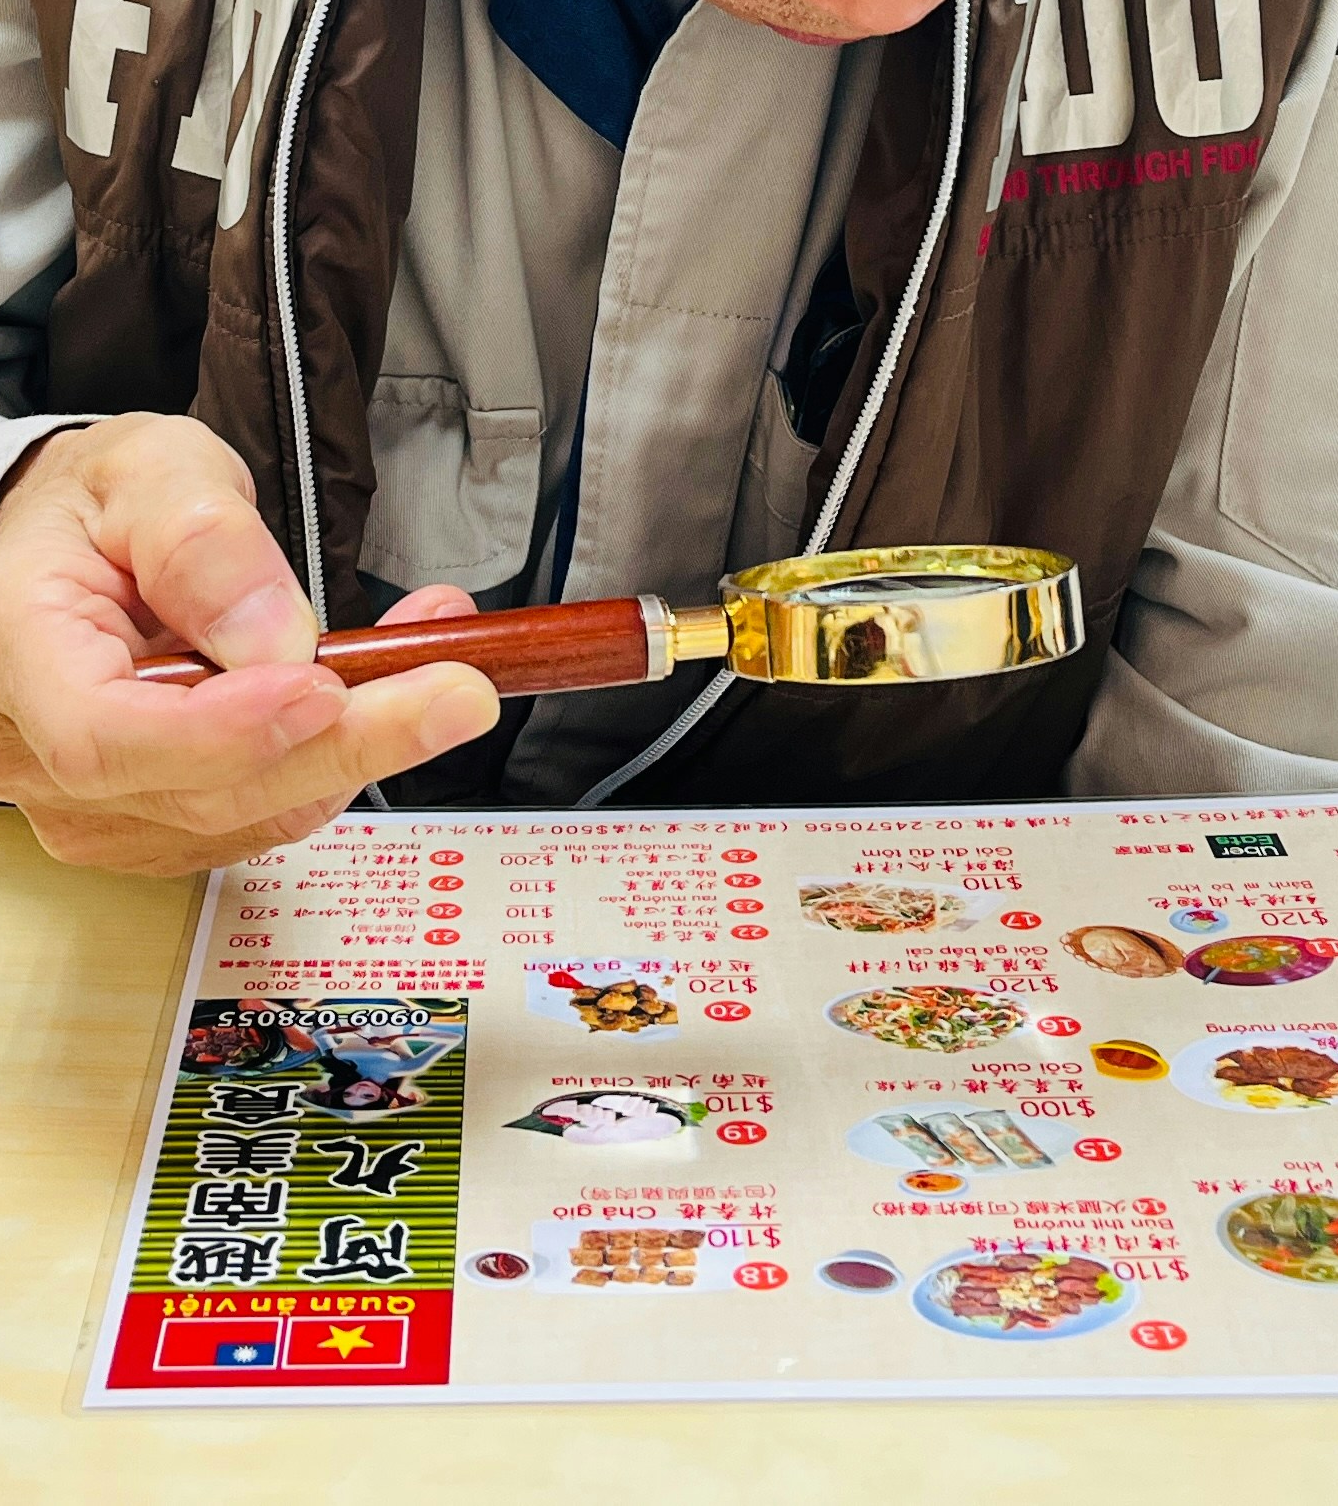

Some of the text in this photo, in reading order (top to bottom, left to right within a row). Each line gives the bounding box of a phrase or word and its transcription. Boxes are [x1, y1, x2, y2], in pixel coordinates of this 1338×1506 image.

[1036, 148, 1191, 196] THROUGH
[1216, 834, 1274, 847] Eats
[309, 843, 367, 855] chanh
[861, 849, 902, 862] tôm
[941, 847, 969, 858] đu
[1221, 845, 1280, 857] Uber
[248, 855, 285, 867] $70
[500, 854, 554, 867] $200
[243, 880, 282, 893] $70
[509, 881, 556, 893] $110
[963, 875, 1022, 891] $110
[1167, 884, 1202, 893] kho
[1211, 882, 1234, 892] bò
[239, 907, 279, 920] $70
[506, 906, 553, 919] $110
[1260, 909, 1328, 927] $120
[229, 934, 272, 948] $90
[502, 932, 555, 945] $100
[243, 981, 300, 991] 20:00
[325, 980, 382, 991] 07:00
[689, 977, 757, 995] $120
[990, 976, 1057, 993] $120
[216, 1009, 430, 1027] 0909-028055
[971, 1062, 1083, 1077] Gỏi cuốn
[706, 1095, 773, 1114] $110
[1020, 1099, 1095, 1117] $100
[1284, 1161, 1324, 1172] kho
[168, 1080, 301, 1285] 越南美食
[299, 1137, 423, 1283] 阿九
[708, 1227, 782, 1249] $110
[1113, 1258, 1189, 1282] $110
[160, 1293, 417, 1318] Quán ăn việt
